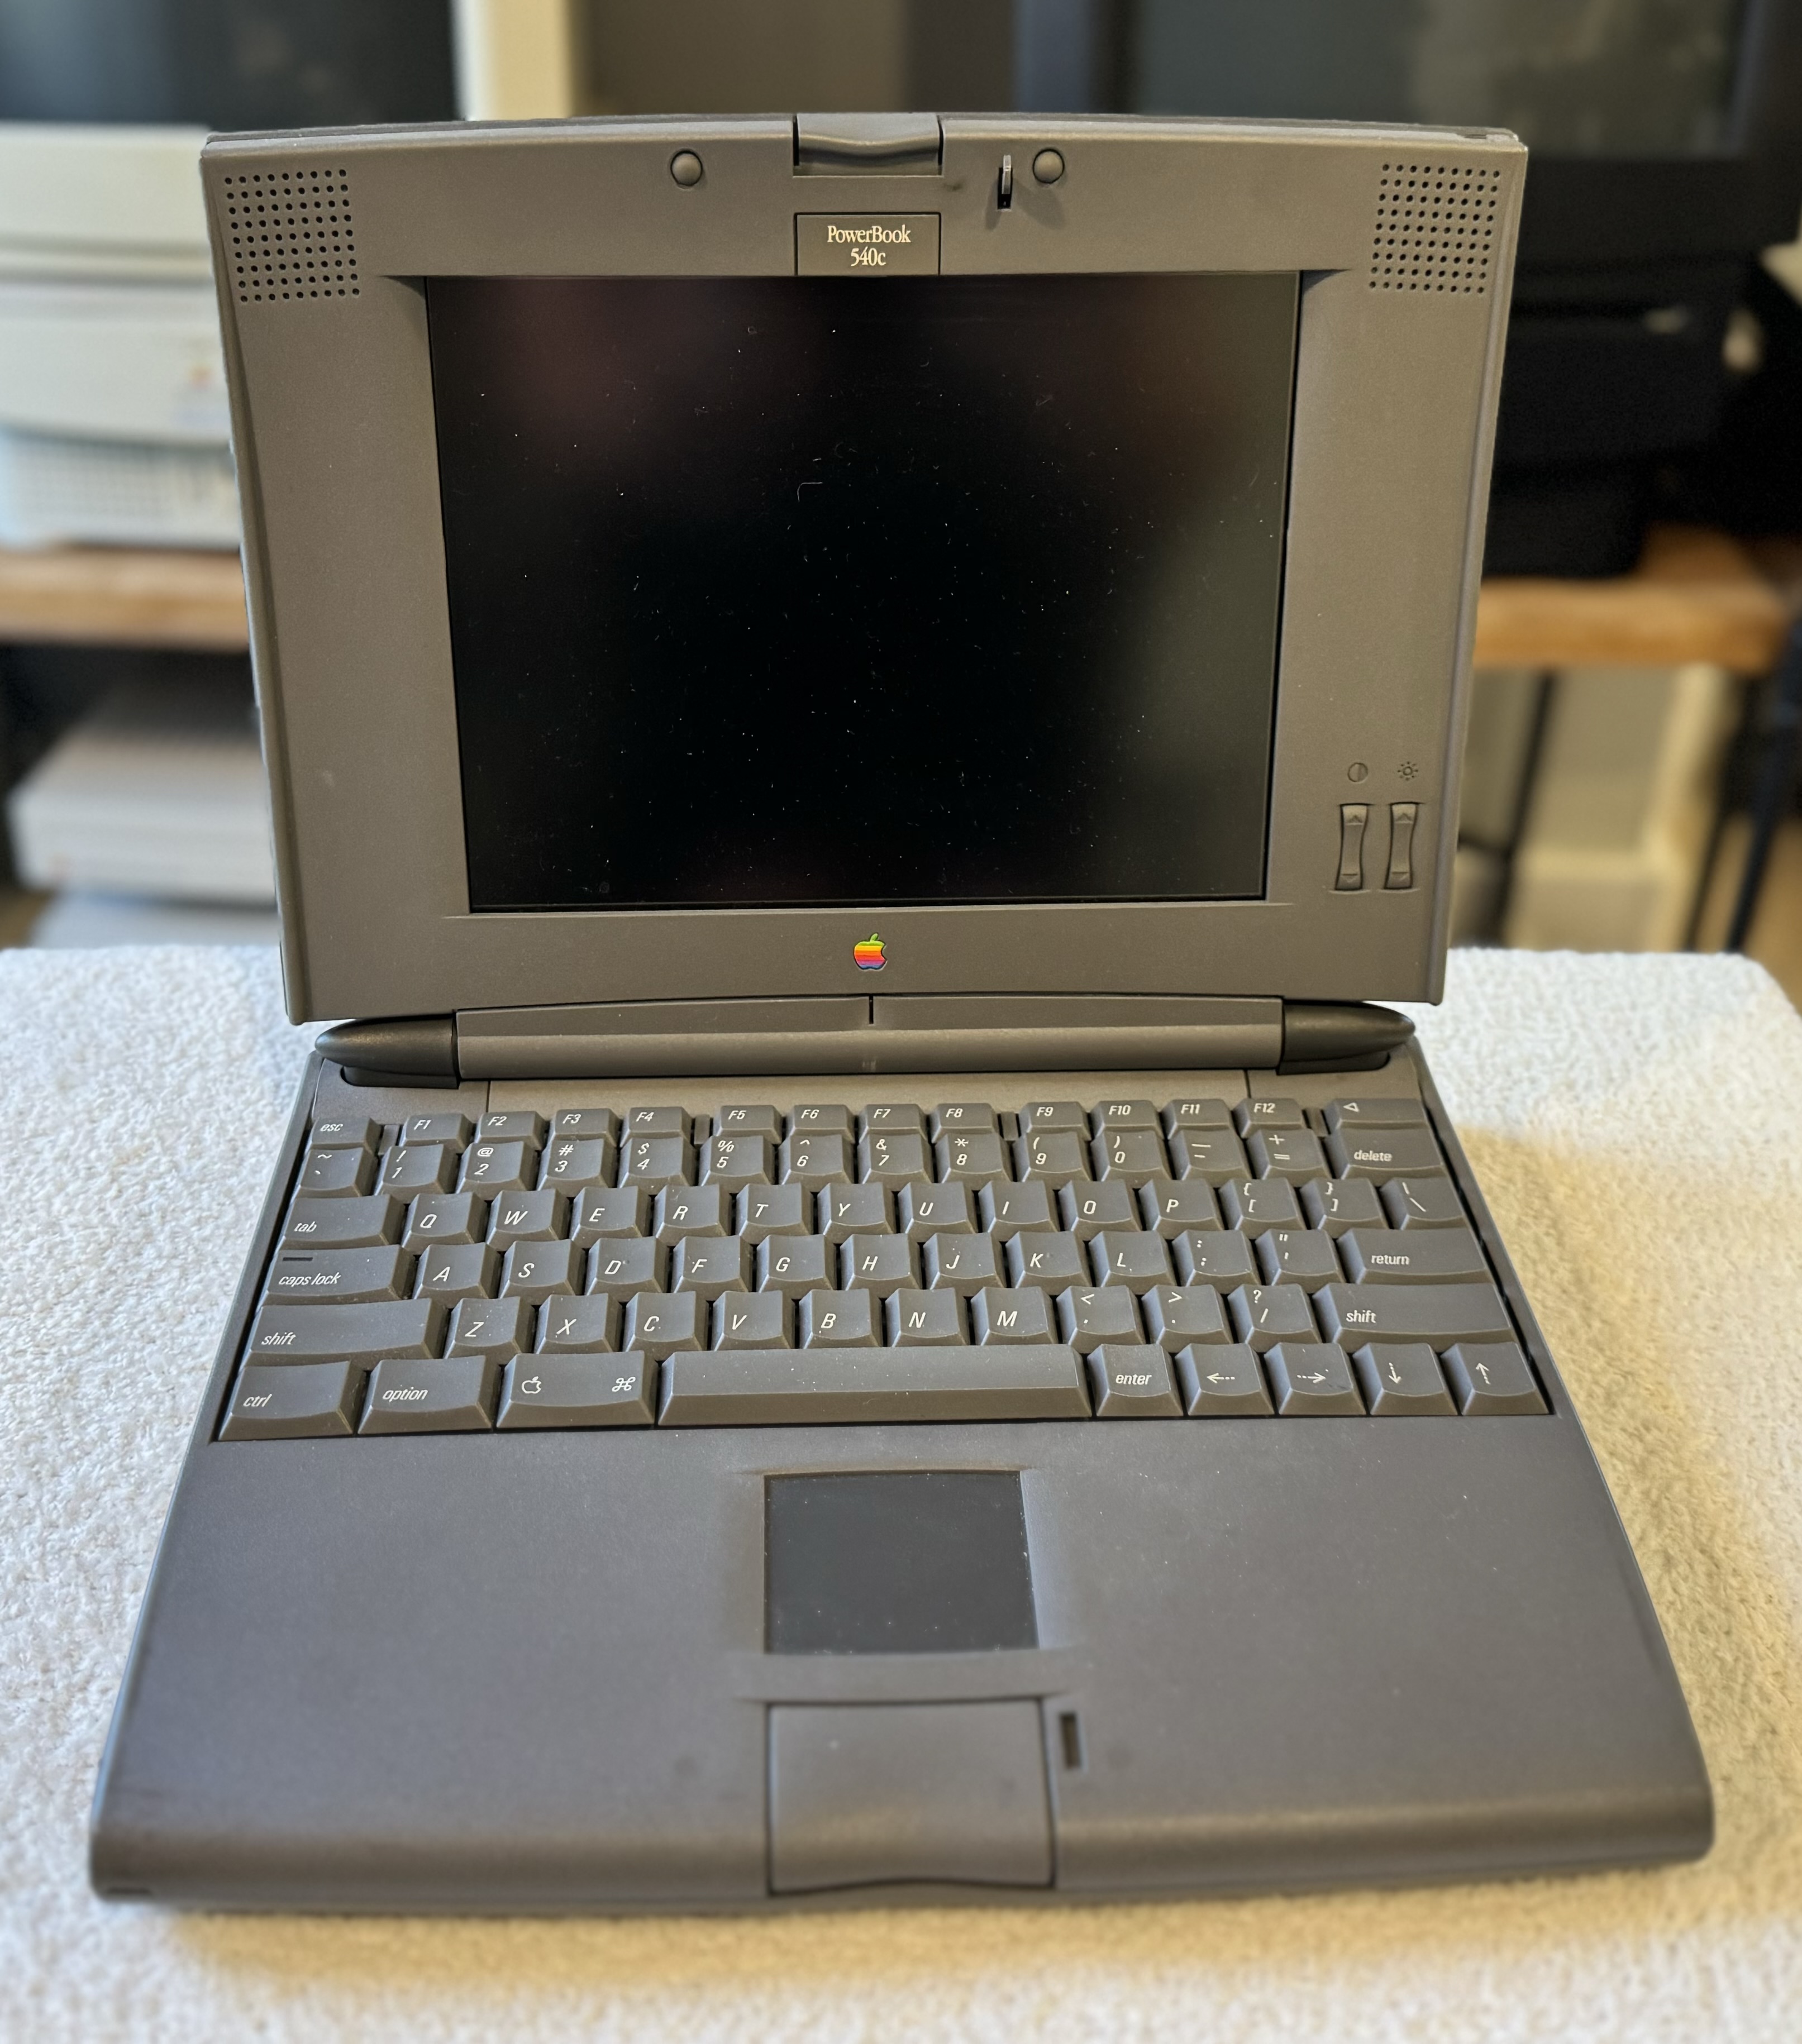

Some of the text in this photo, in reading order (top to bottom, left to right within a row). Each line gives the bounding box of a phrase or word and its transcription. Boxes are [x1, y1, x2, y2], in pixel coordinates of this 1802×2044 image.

[827, 224, 911, 243] PowerBook
[850, 246, 886, 266] 540c
[800, 1109, 819, 1119] F6
[873, 1109, 891, 1119] F7
[946, 1108, 963, 1118] F8
[1036, 1106, 1053, 1117] F9
[1108, 1105, 1131, 1115] F10
[1180, 1104, 1200, 1114] F11
[1253, 1102, 1275, 1113] F12
[488, 1116, 507, 1126] F2
[562, 1114, 581, 1124] F3
[636, 1112, 654, 1122] F4
[728, 1110, 747, 1120] F5
[320, 1124, 344, 1132] esc
[413, 1120, 431, 1130] F1
[875, 1139, 887, 1150] &
[1033, 1136, 1040, 1150] (
[1113, 1135, 1121, 1149] )
[1269, 1134, 1285, 1145] +
[477, 1147, 494, 1157] @
[559, 1144, 574, 1156] #
[637, 1143, 650, 1155] $
[718, 1140, 735, 1153] %
[396, 1150, 407, 1162] !
[716, 1156, 729, 1168] 5
[797, 1155, 809, 1167] 6
[879, 1154, 890, 1166] 7
[956, 1153, 967, 1166] 8
[1035, 1153, 1047, 1164] 9
[1114, 1151, 1126, 1163] 0
[1353, 1149, 1392, 1162] delete
[474, 1163, 489, 1176] 2
[555, 1160, 568, 1172] 3
[637, 1158, 650, 1170] 4
[392, 1167, 402, 1178] 1
[1243, 1182, 1252, 1196] {
[1325, 1182, 1333, 1195] }
[755, 1204, 769, 1217] T
[838, 1203, 851, 1217] Y
[919, 1202, 934, 1216] U
[1002, 1201, 1009, 1215] I
[1083, 1200, 1097, 1215] O
[1166, 1199, 1179, 1213] P
[1248, 1199, 1256, 1212] [
[1330, 1198, 1338, 1212] ]
[504, 1210, 528, 1225] W
[589, 1208, 606, 1222] E
[673, 1206, 688, 1220] R
[294, 1221, 317, 1233] tab
[419, 1214, 437, 1229] Q
[692, 1259, 708, 1273] F
[775, 1257, 790, 1272] G
[862, 1256, 878, 1271] H
[946, 1255, 960, 1269] J
[1029, 1253, 1044, 1268] K
[1117, 1252, 1126, 1267] L
[1371, 1255, 1409, 1265] return
[518, 1263, 535, 1278] S
[604, 1260, 622, 1274] D
[278, 1272, 341, 1287] caps lock
[432, 1266, 450, 1282] A
[1081, 1293, 1095, 1305] <
[1168, 1292, 1183, 1303] >
[1253, 1290, 1262, 1303] ?
[732, 1314, 747, 1330] V
[821, 1313, 836, 1329] B
[908, 1312, 926, 1329] N
[997, 1311, 1018, 1327] M
[1346, 1310, 1376, 1324] shift
[464, 1321, 484, 1338] Z
[556, 1319, 577, 1335] X
[643, 1316, 660, 1332] C
[261, 1332, 296, 1345] shift
[1115, 1374, 1152, 1386] enter
[243, 1393, 273, 1407] ctrl
[382, 1386, 428, 1402] option
